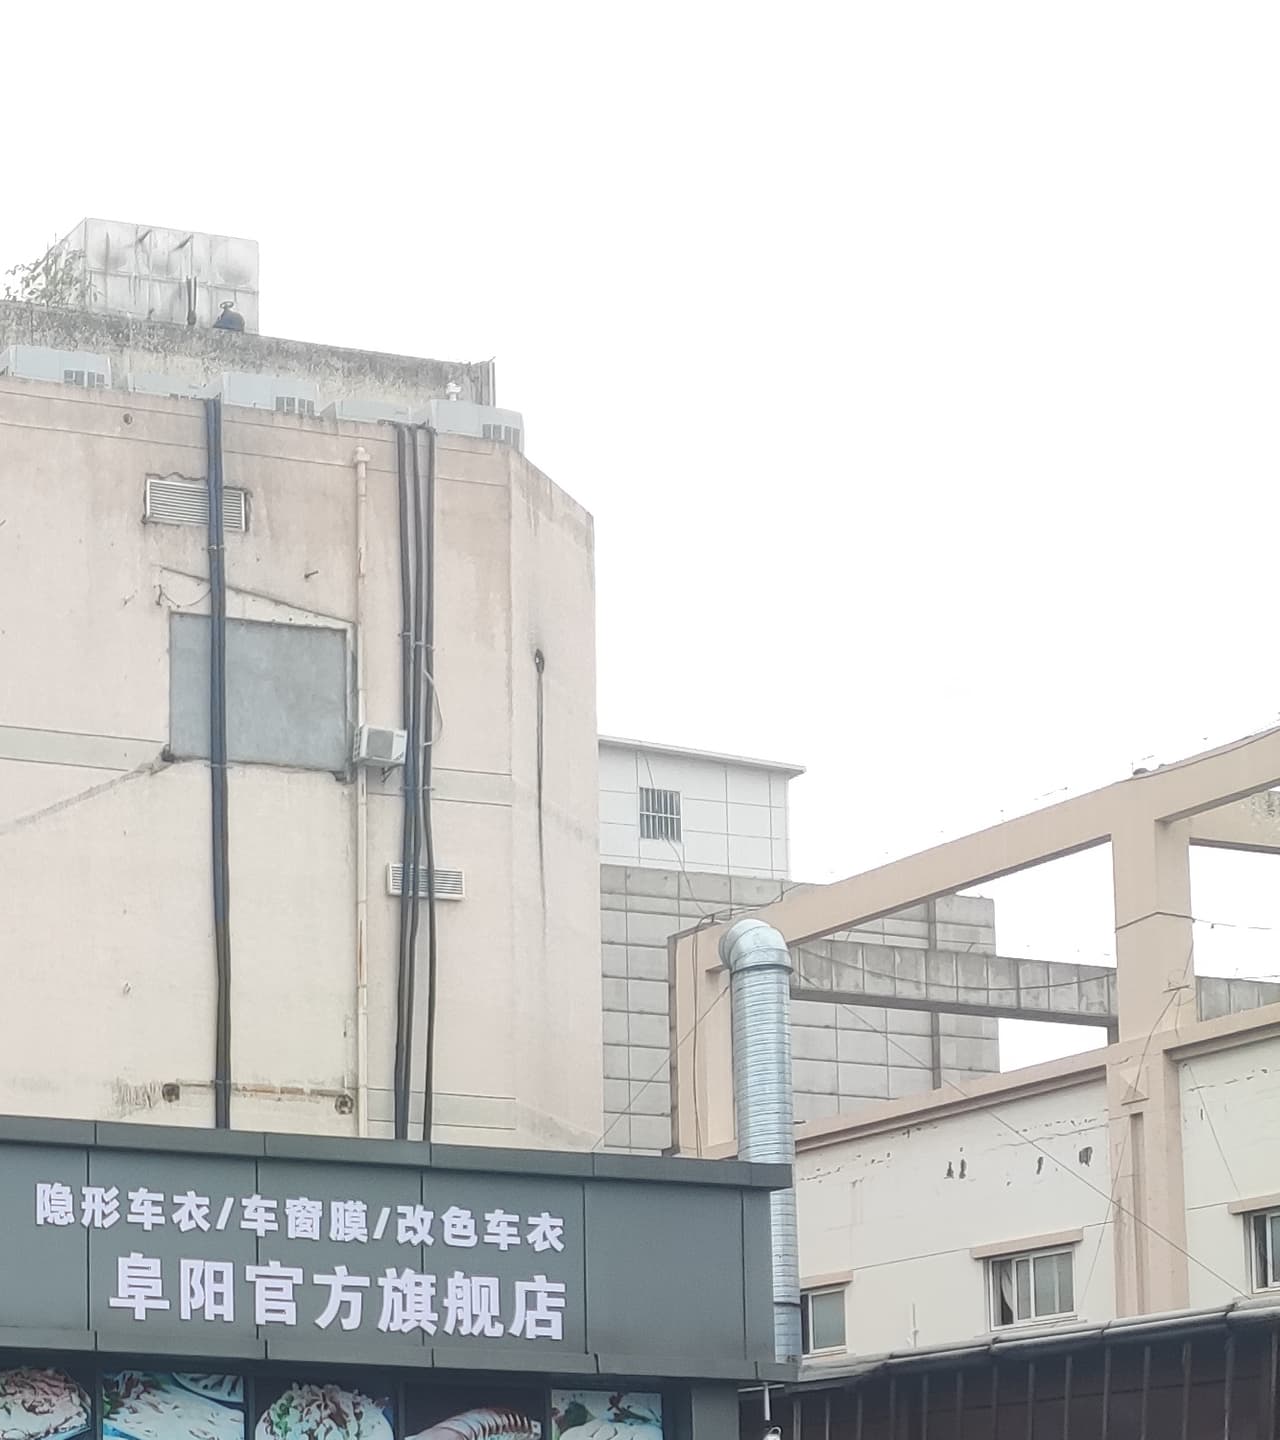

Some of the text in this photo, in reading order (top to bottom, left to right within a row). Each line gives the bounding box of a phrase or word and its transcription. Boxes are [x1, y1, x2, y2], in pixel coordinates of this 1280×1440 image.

[35, 1182, 565, 1252] 隐形车衣/车窗膜/改色车衣
[108, 1252, 567, 1341] 阜阳官方旗舰店
